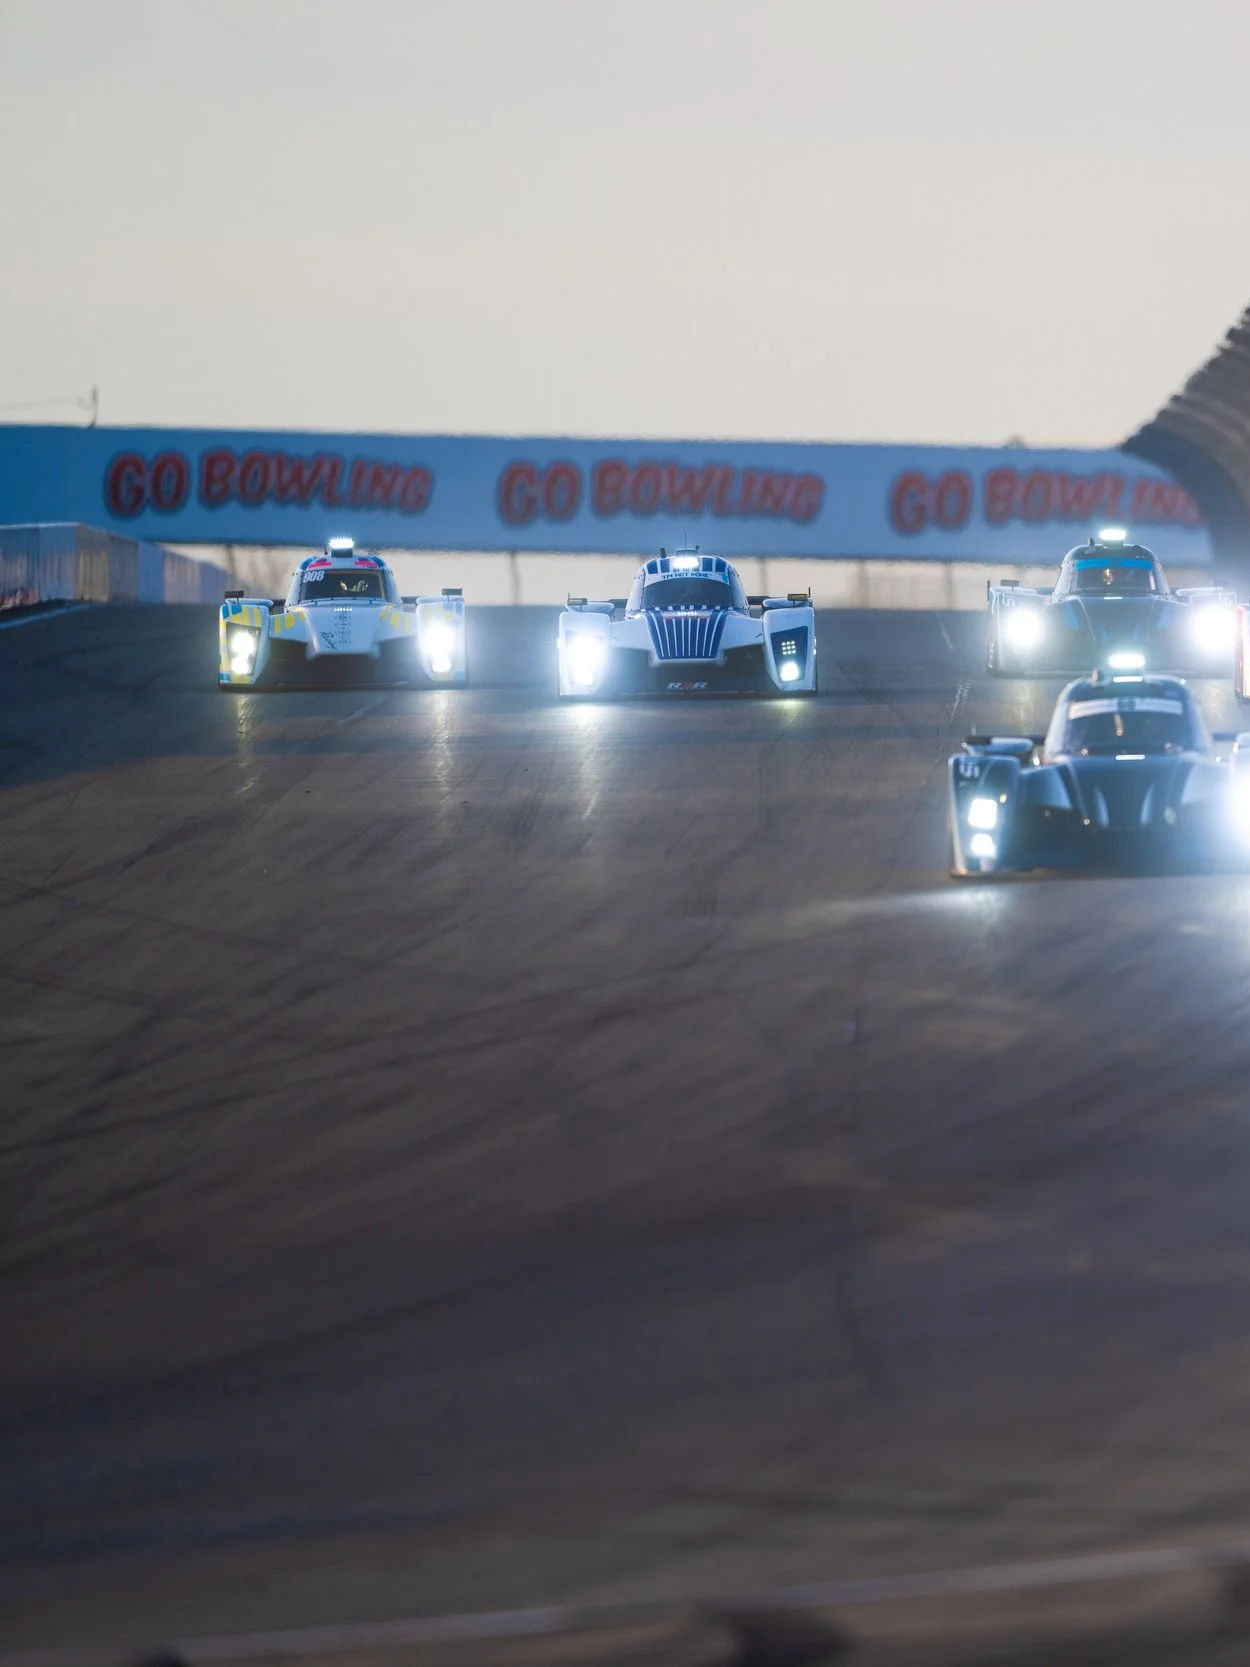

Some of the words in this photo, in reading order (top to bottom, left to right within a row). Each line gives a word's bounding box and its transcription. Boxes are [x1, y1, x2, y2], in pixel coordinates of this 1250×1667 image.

[106, 452, 189, 517] GO
[199, 447, 433, 512] BOWLING
[499, 460, 582, 526] GO
[593, 458, 825, 525] BOWLING
[891, 471, 973, 534] GO
[302, 570, 326, 583] 908
